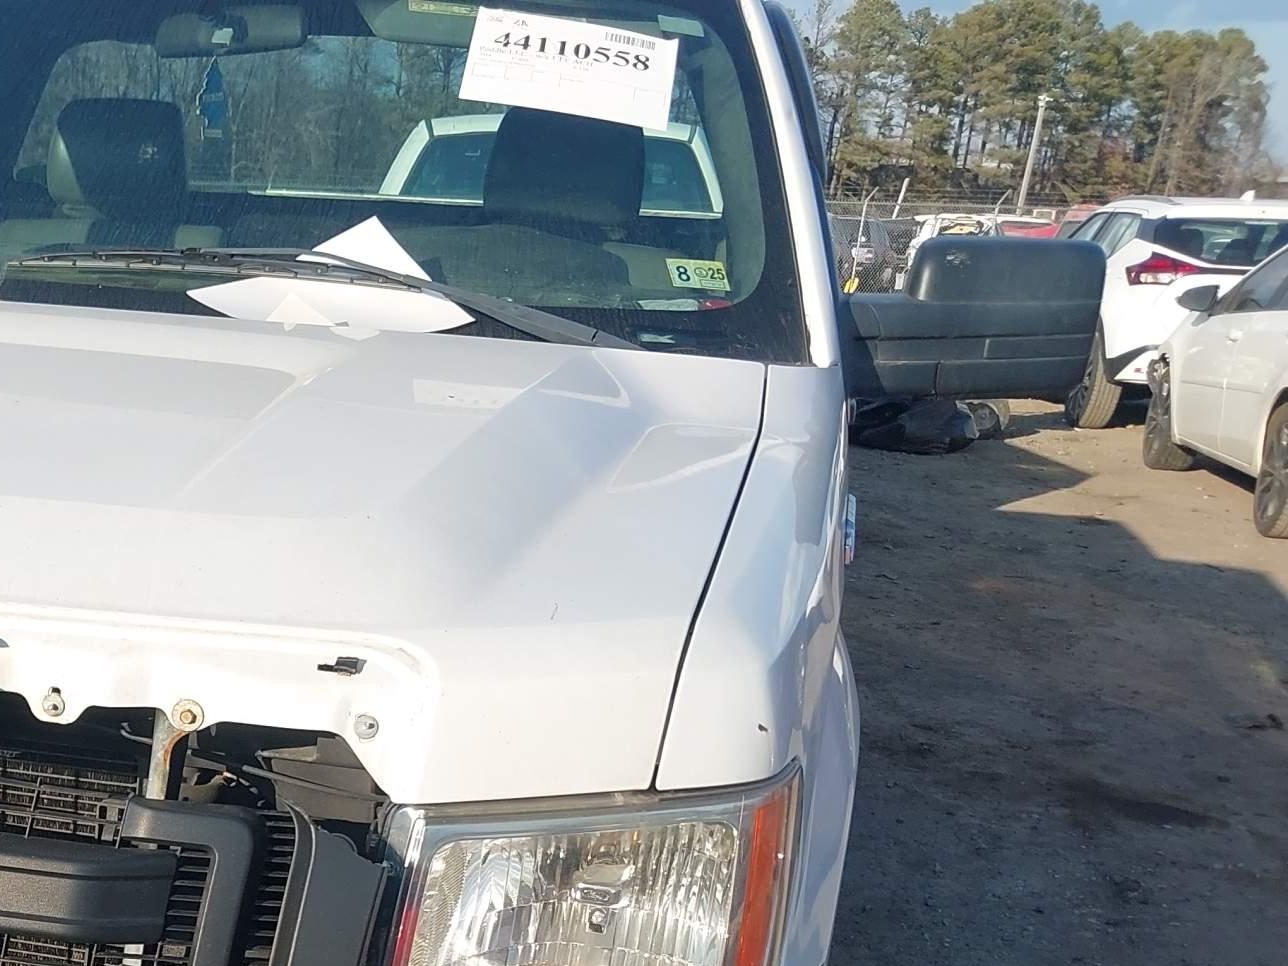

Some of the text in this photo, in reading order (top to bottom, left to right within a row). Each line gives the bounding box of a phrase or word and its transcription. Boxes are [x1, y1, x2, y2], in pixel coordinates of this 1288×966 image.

[494, 32, 650, 72] 44110558
[675, 265, 725, 282] 8 25
